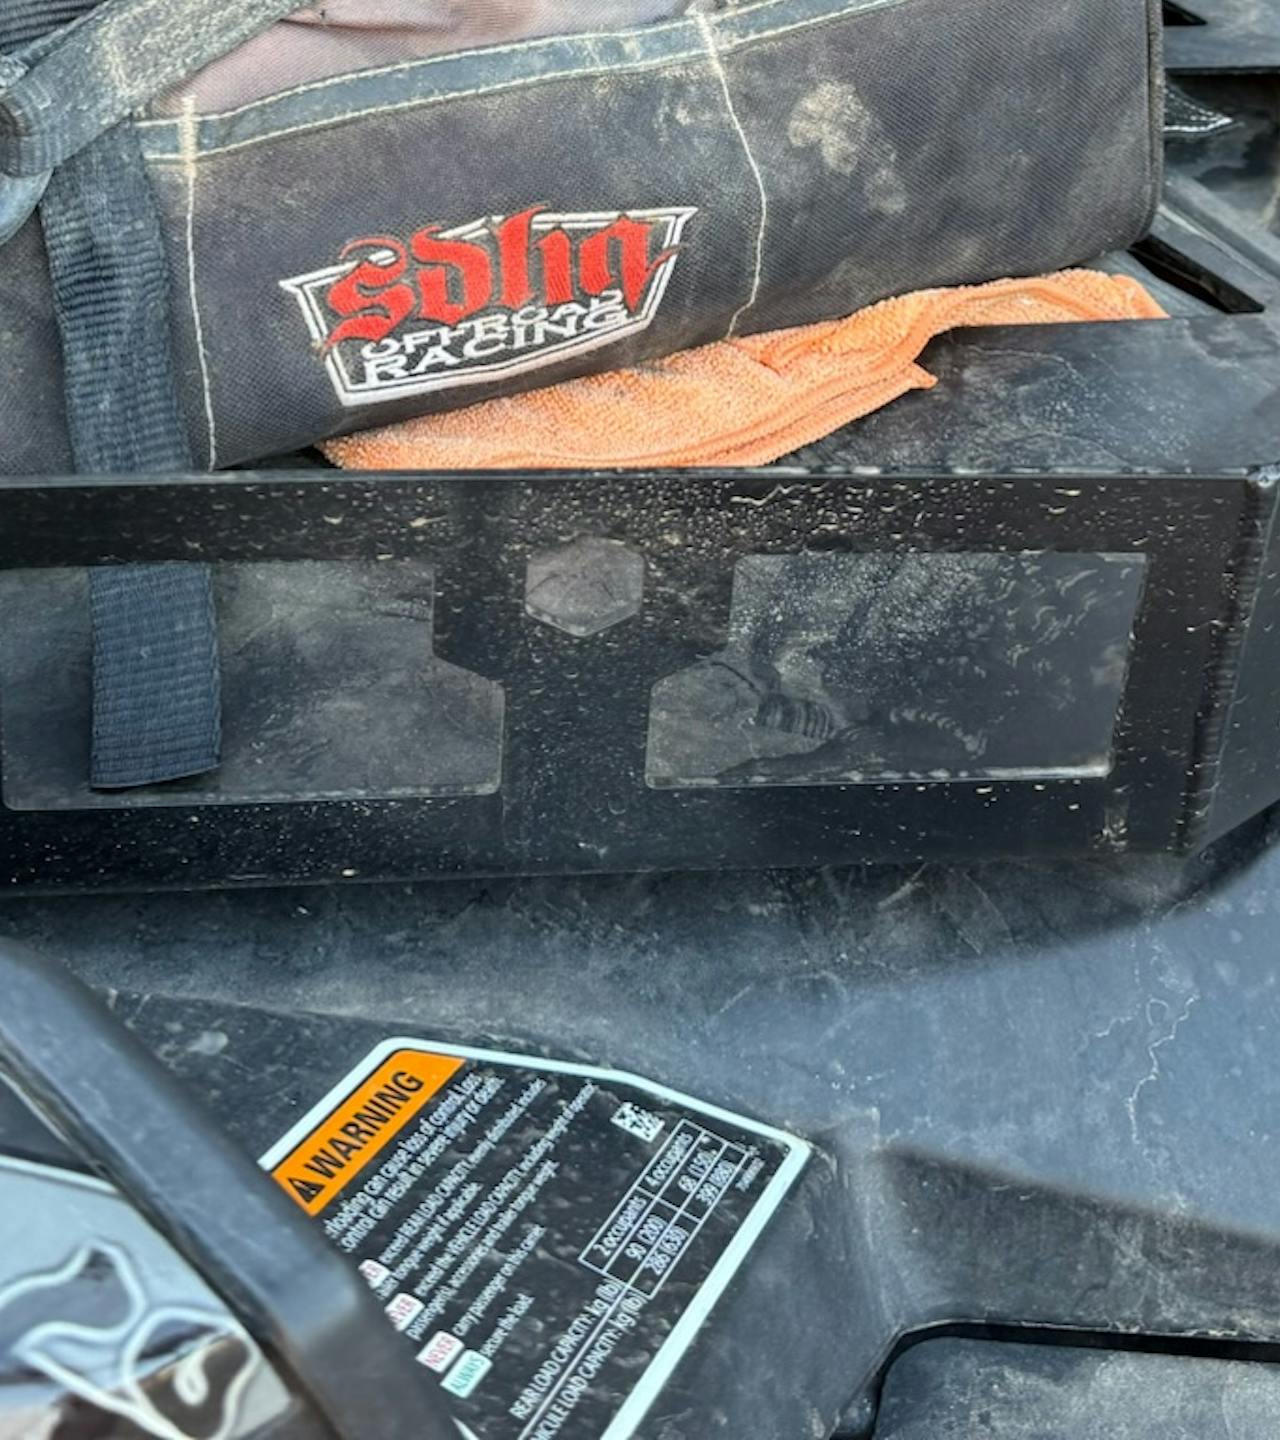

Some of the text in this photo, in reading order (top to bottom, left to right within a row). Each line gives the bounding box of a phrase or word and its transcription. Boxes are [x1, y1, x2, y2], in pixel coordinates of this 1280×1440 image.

[360, 288, 625, 361] OFFROAD
[363, 301, 630, 386] RACING
[304, 1071, 424, 1180] WARNING
[359, 1173, 389, 1196] can
[376, 1147, 413, 1178] cause
[397, 1128, 429, 1153] loss
[413, 1118, 439, 1136] of
[452, 1070, 484, 1095] Loss
[439, 1107, 480, 1141] injury
[462, 1099, 484, 1115] or
[405, 1162, 426, 1176] in
[415, 1133, 454, 1167] severe
[642, 1129, 696, 1189] 4 occupants
[365, 1196, 395, 1220] can
[378, 1168, 420, 1203] result
[373, 1231, 410, 1265] exceed
[397, 1212, 428, 1238] REAR
[414, 1192, 446, 1218] LOAD
[432, 1249, 457, 1269] the
[469, 1199, 499, 1226] LOAD
[593, 1193, 650, 1256] 2 occupants
[622, 1212, 669, 1262] 90 (200)
[642, 1248, 673, 1276] 286
[421, 1334, 457, 1369] NEVER
[449, 1310, 482, 1339] carry
[466, 1272, 512, 1318] passenger
[497, 1260, 517, 1277] on
[478, 1326, 509, 1358] secure
[493, 1309, 520, 1331] the
[448, 1354, 486, 1393] ALWAYS
[507, 1386, 542, 1420] REAR
[527, 1357, 562, 1393] LOAD
[547, 1309, 596, 1364] CAPACITY:
[582, 1295, 611, 1318] kg
[554, 1373, 590, 1410] LOAD
[574, 1324, 623, 1380] CAPACITY:
[607, 1309, 638, 1333] kg
